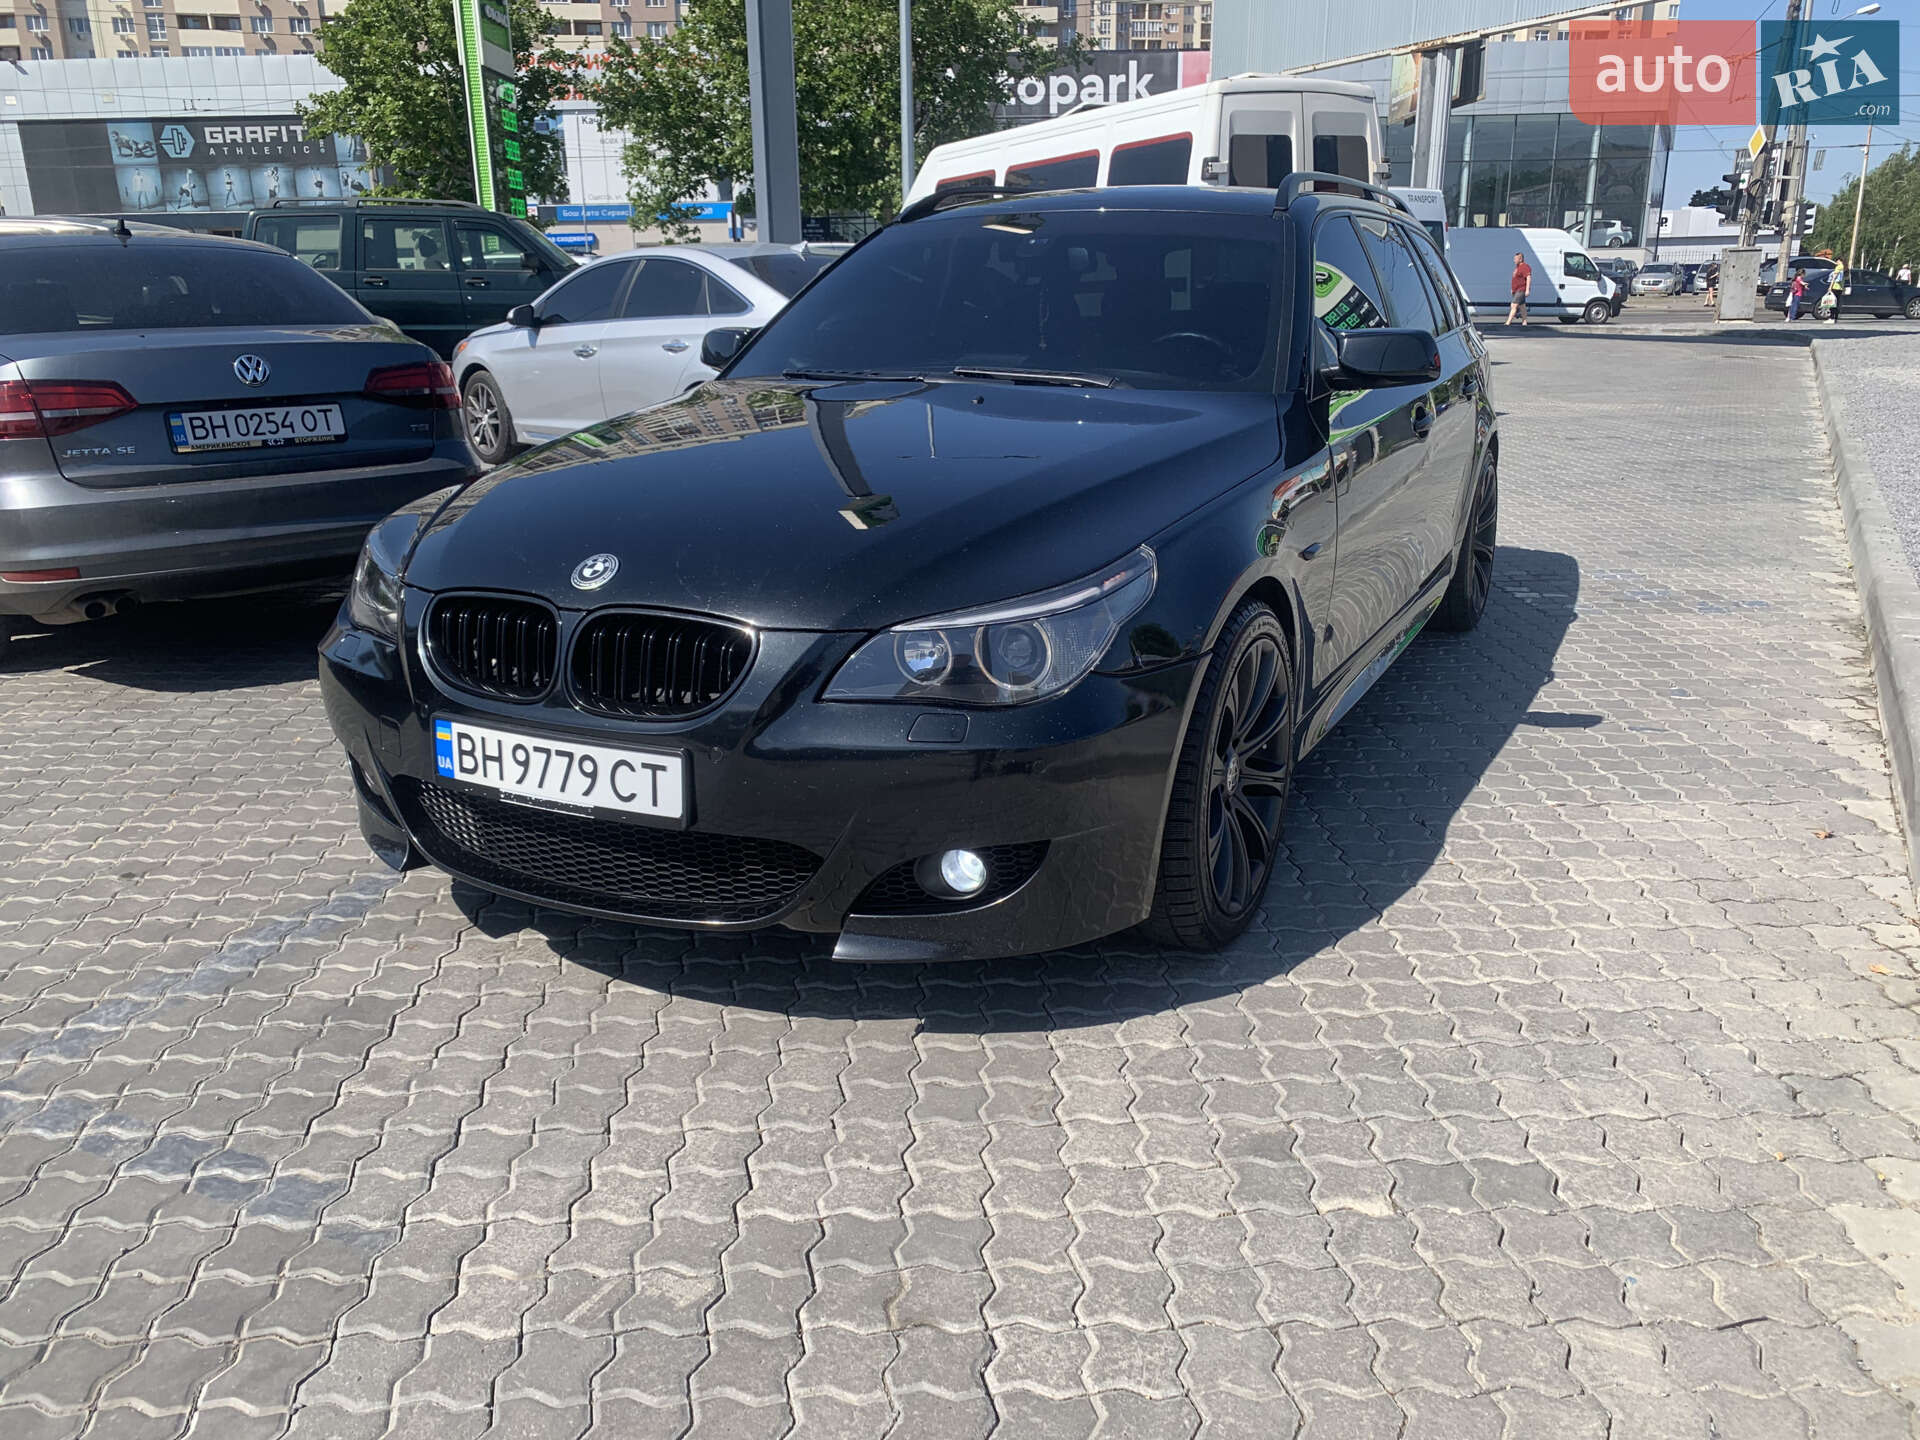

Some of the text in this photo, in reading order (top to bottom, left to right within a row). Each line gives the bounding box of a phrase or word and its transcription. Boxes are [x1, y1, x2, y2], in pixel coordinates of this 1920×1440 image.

[203, 125, 307, 144] GRAFIT
[208, 145, 310, 156] ATHLETIC
[188, 408, 334, 440] BH 0254 OT
[173, 434, 187, 443] UA
[62, 445, 136, 458] JETTA SE
[438, 755, 453, 771] UA
[457, 732, 504, 782] BH
[511, 743, 599, 797] 9779
[610, 759, 668, 808] CT
